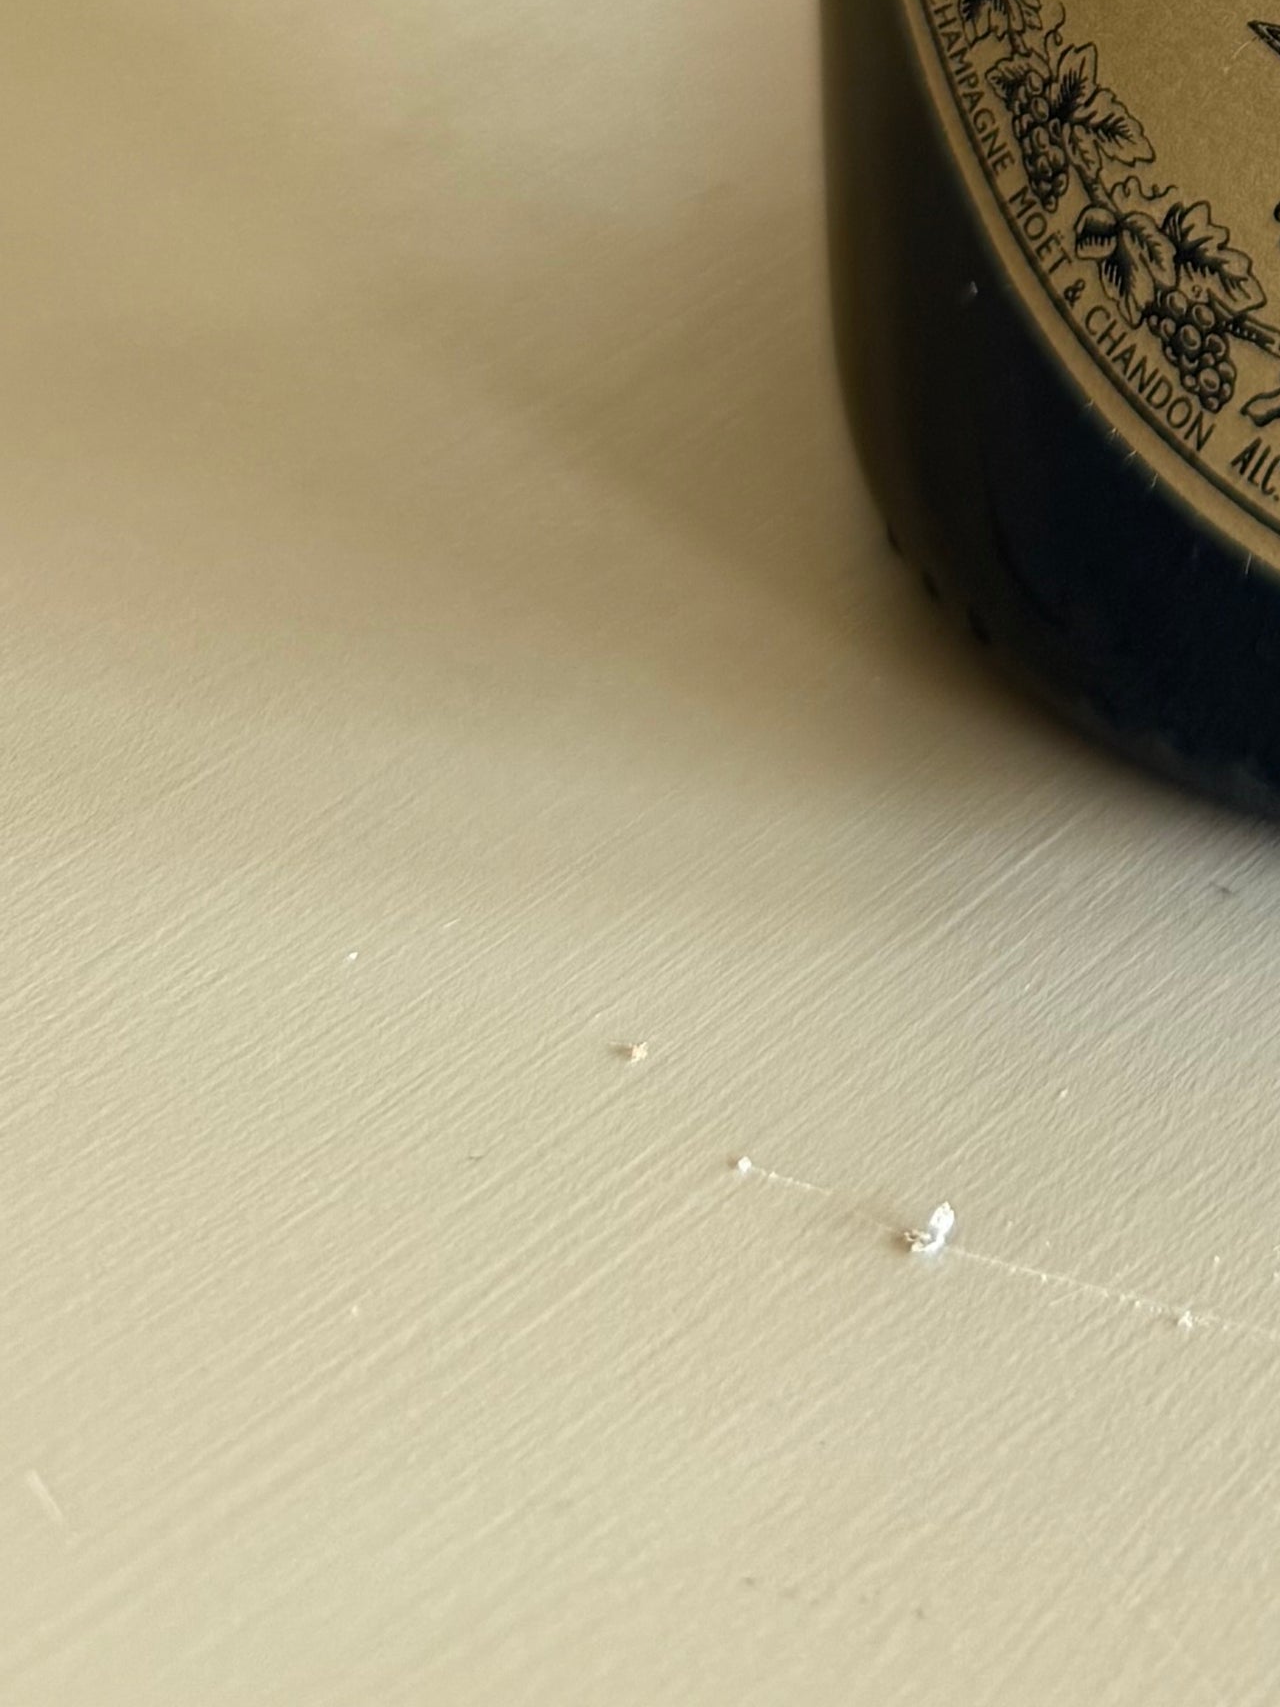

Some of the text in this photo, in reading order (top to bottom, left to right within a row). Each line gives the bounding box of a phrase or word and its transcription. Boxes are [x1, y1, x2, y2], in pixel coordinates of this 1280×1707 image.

[1009, 187, 1074, 277] MOËT
[1064, 278, 1085, 308] &
[1084, 303, 1218, 453] CHANDON
